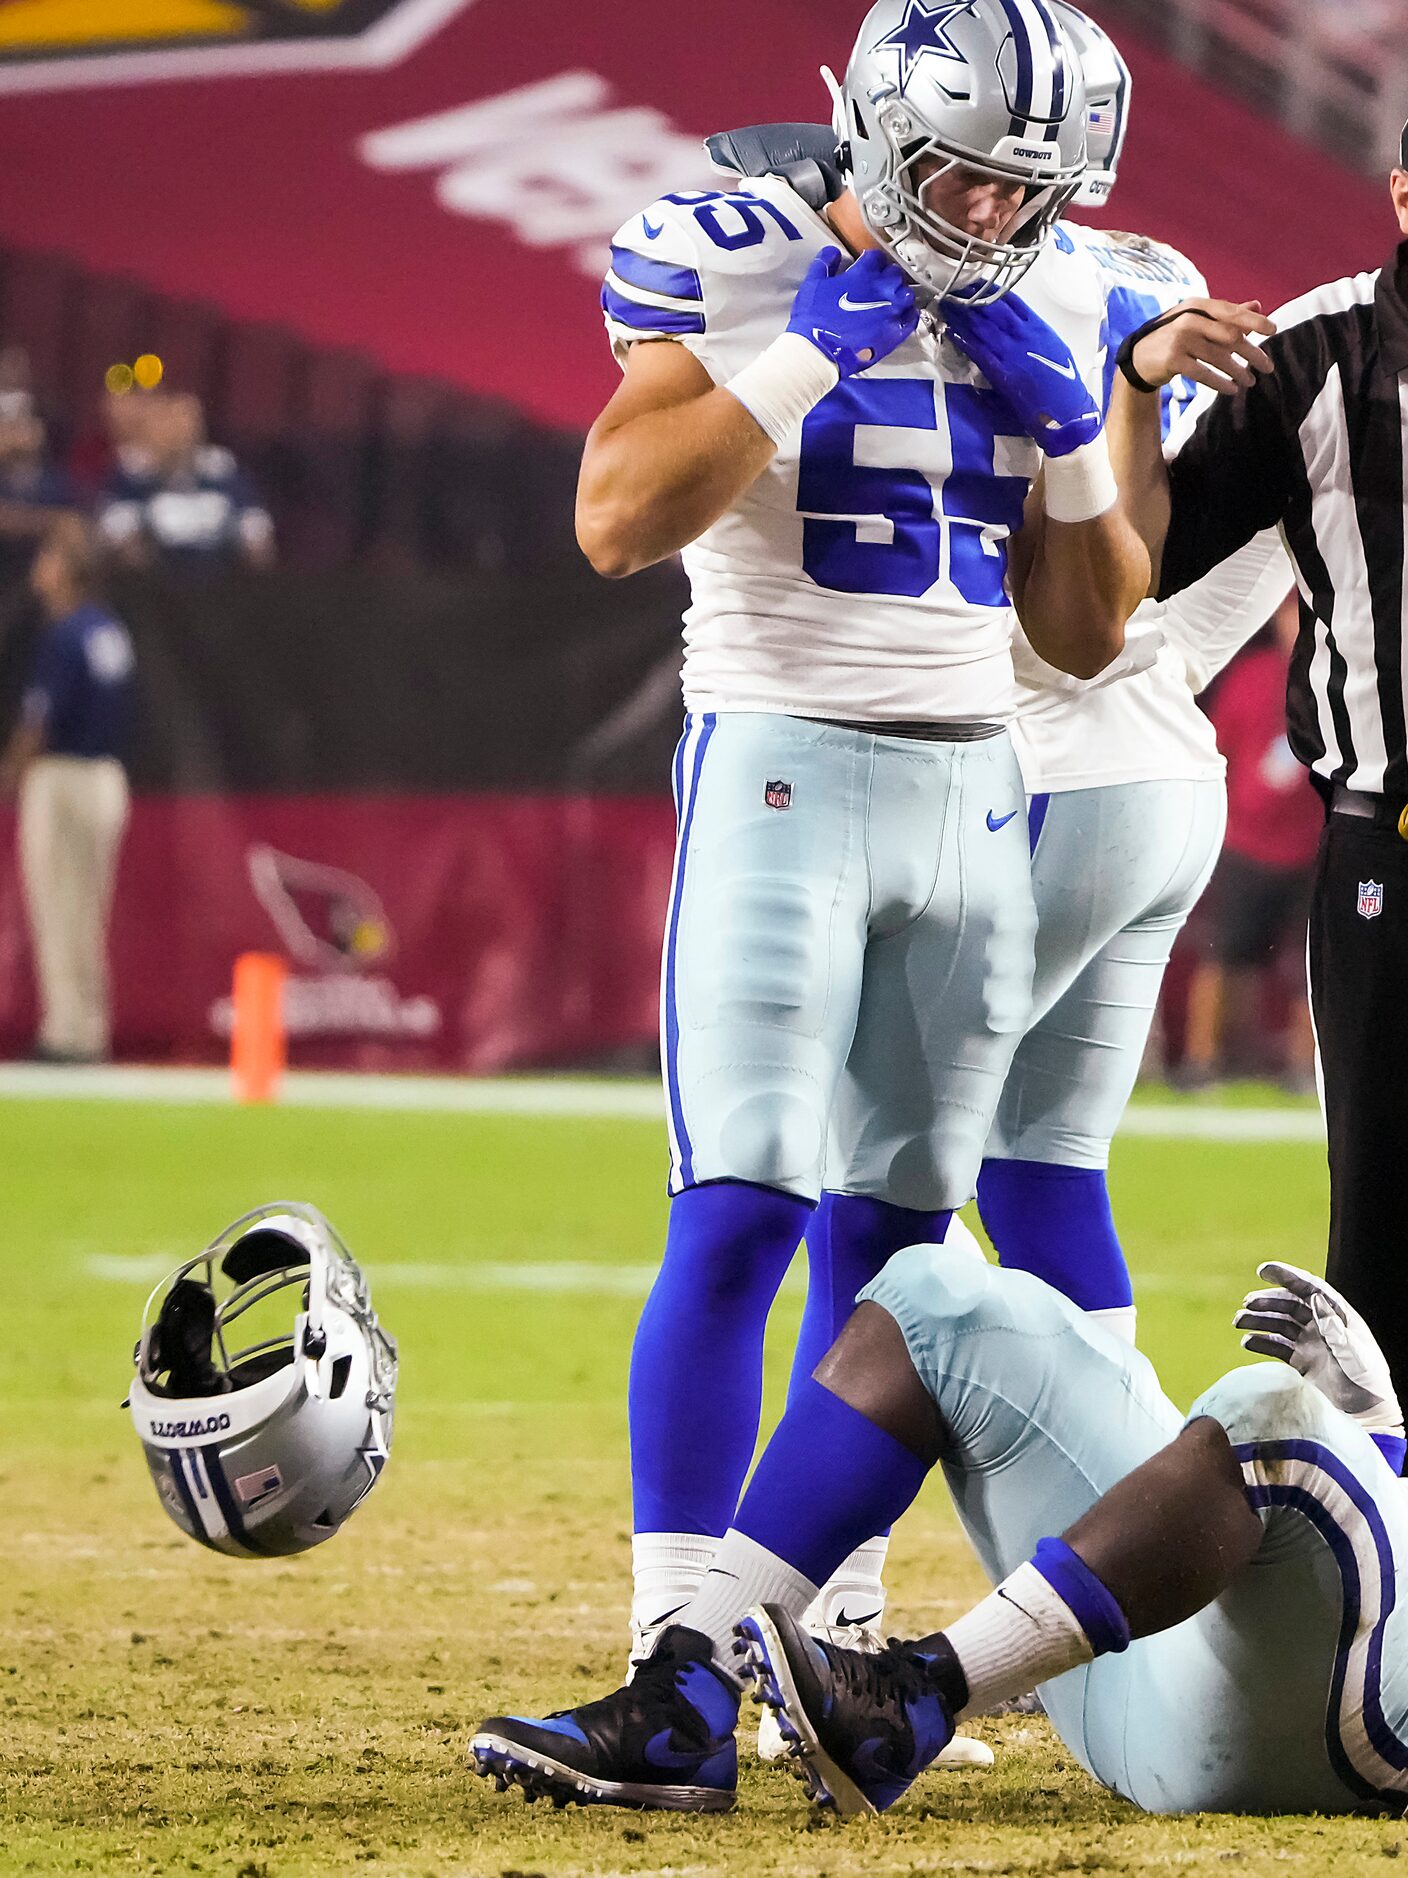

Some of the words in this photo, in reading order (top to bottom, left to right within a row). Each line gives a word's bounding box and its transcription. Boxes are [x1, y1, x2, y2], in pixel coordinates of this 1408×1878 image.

[1013, 147, 1052, 160] COWBOYS
[797, 378, 1036, 607] 55
[1360, 896, 1379, 913] NFL
